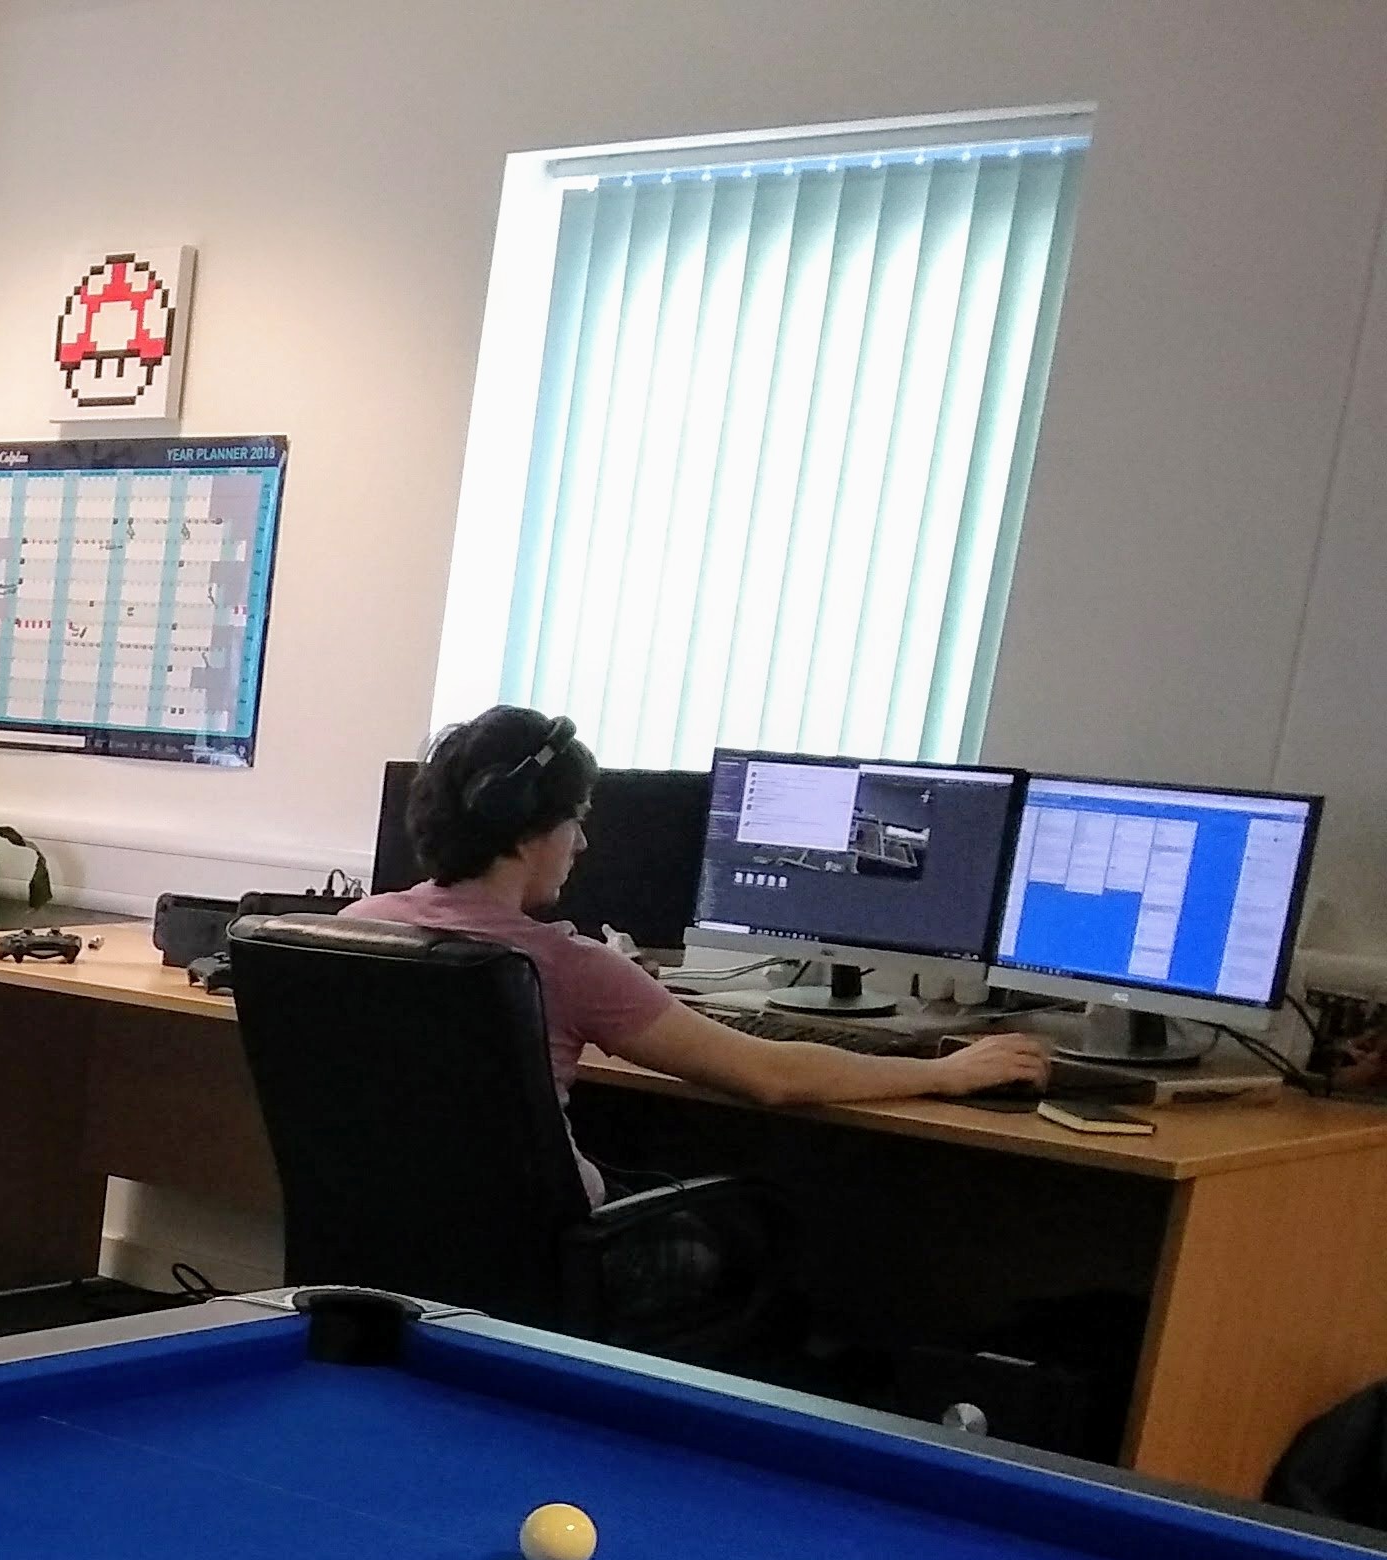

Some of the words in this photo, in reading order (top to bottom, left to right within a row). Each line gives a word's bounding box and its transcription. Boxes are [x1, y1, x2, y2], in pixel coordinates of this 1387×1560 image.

[167, 448, 194, 461] YEAR
[196, 446, 247, 460] PLANNER
[250, 446, 276, 460] 2018
